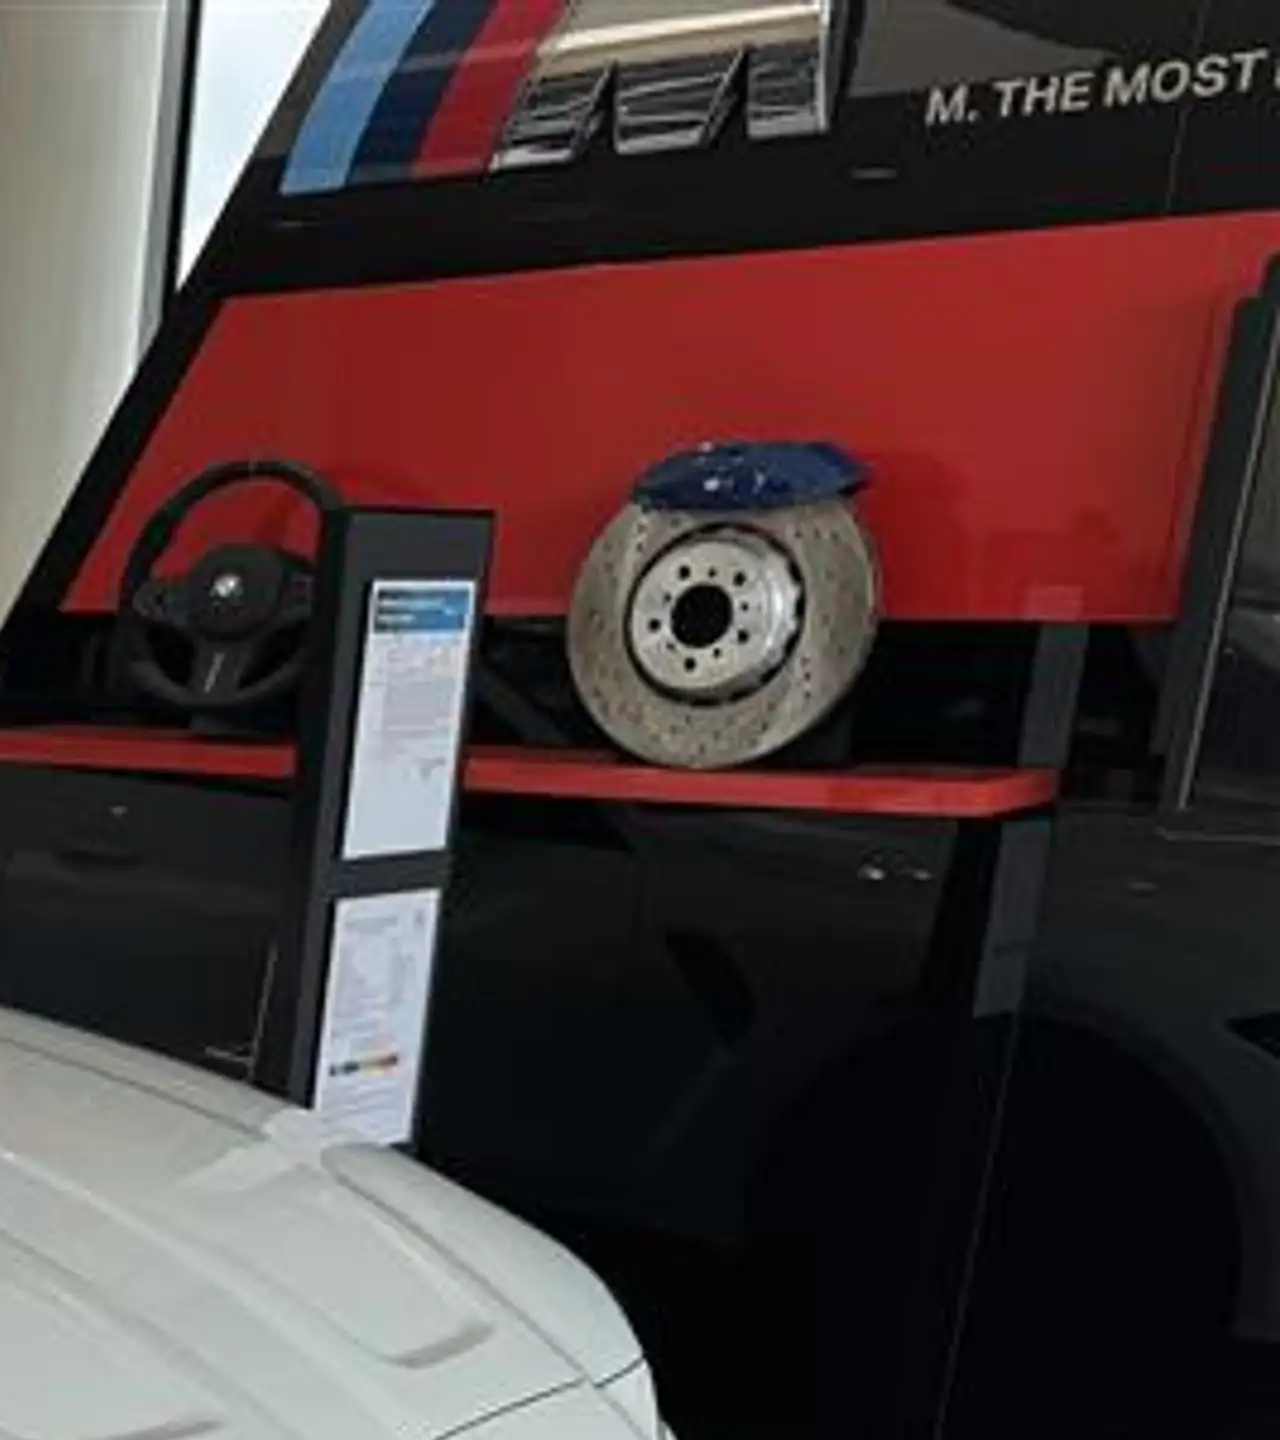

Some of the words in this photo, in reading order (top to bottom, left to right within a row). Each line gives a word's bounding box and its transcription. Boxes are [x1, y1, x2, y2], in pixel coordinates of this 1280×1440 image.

[925, 84, 979, 126] M.
[992, 71, 1096, 118] THE
[1103, 48, 1269, 106] MOST
